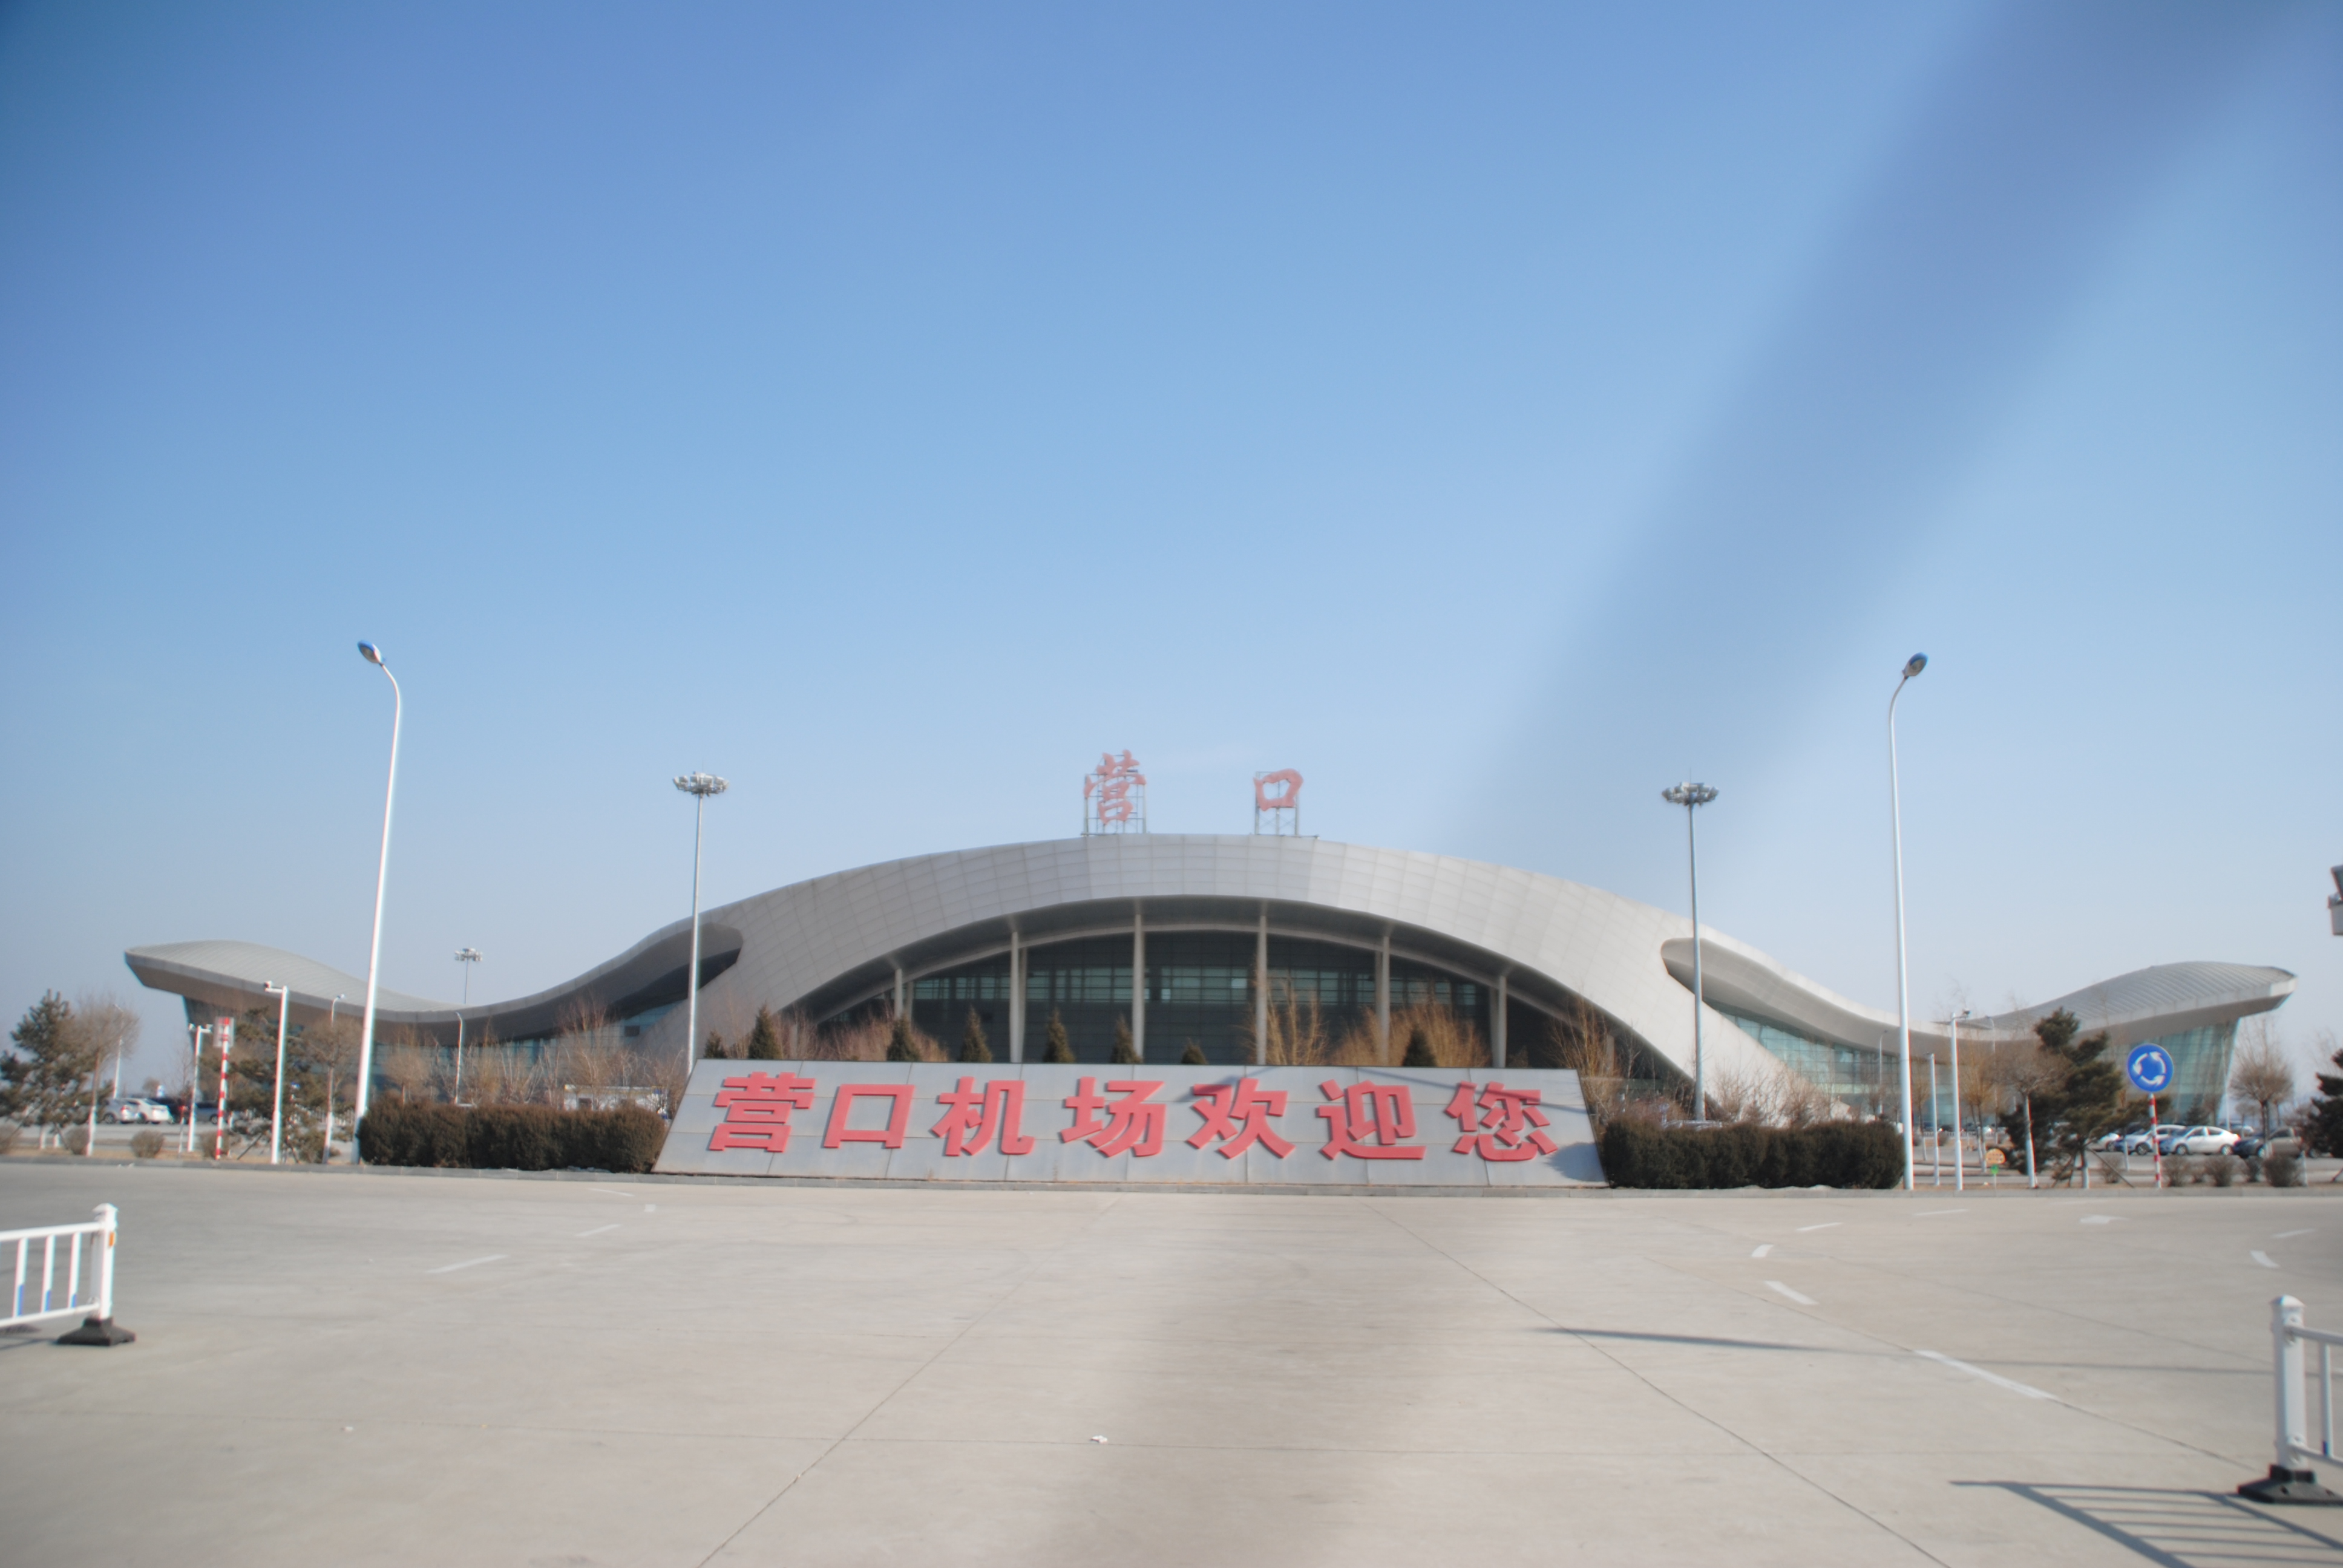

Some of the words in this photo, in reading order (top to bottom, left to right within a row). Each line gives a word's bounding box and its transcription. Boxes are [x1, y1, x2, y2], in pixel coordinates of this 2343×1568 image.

[709, 1071, 1559, 1163] 营口机场欢迎您
